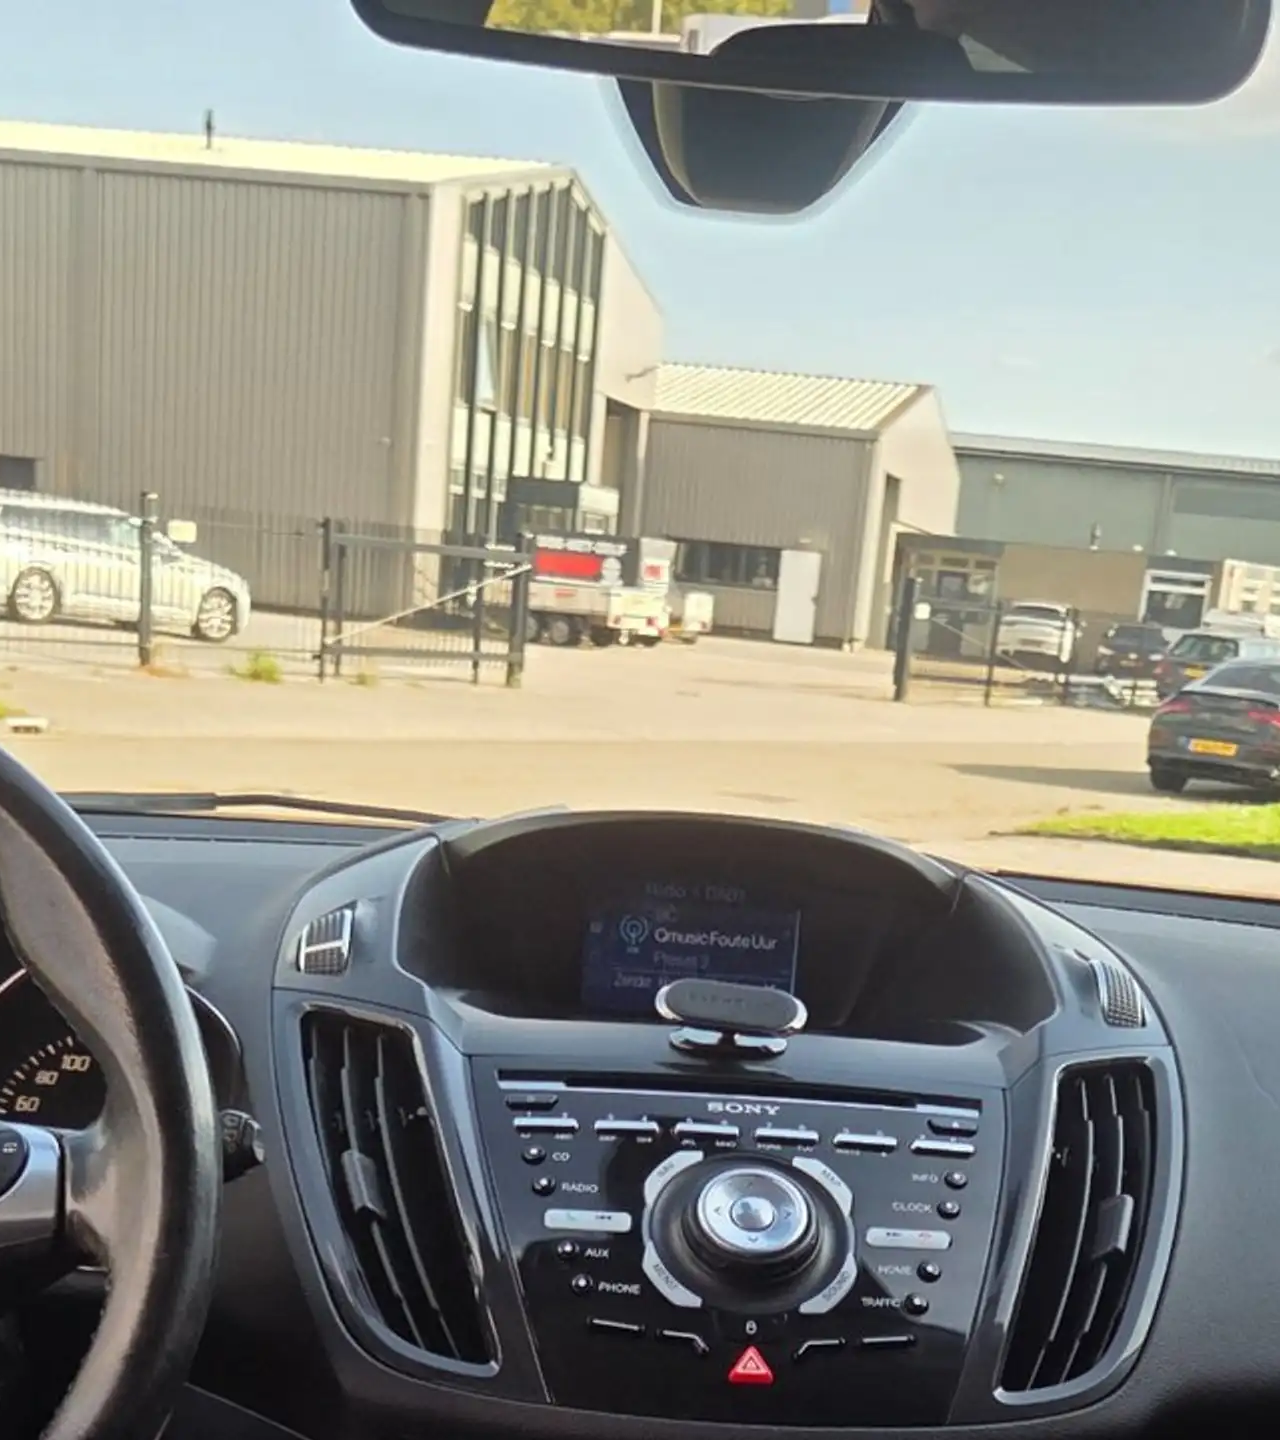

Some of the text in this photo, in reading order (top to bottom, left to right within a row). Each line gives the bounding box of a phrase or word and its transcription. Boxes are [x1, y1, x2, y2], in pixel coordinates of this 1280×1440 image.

[60, 1054, 91, 1073] 100
[35, 1070, 60, 1086] 80
[14, 1095, 40, 1112] 60
[707, 1101, 781, 1116] SONY
[552, 1152, 570, 1162] CD
[911, 1173, 939, 1184] INFO
[561, 1182, 599, 1194] RADIO
[891, 1202, 934, 1214] CLOCK
[584, 1247, 609, 1258] AUX
[598, 1282, 641, 1295] PHONE
[822, 1270, 850, 1302] SOUND
